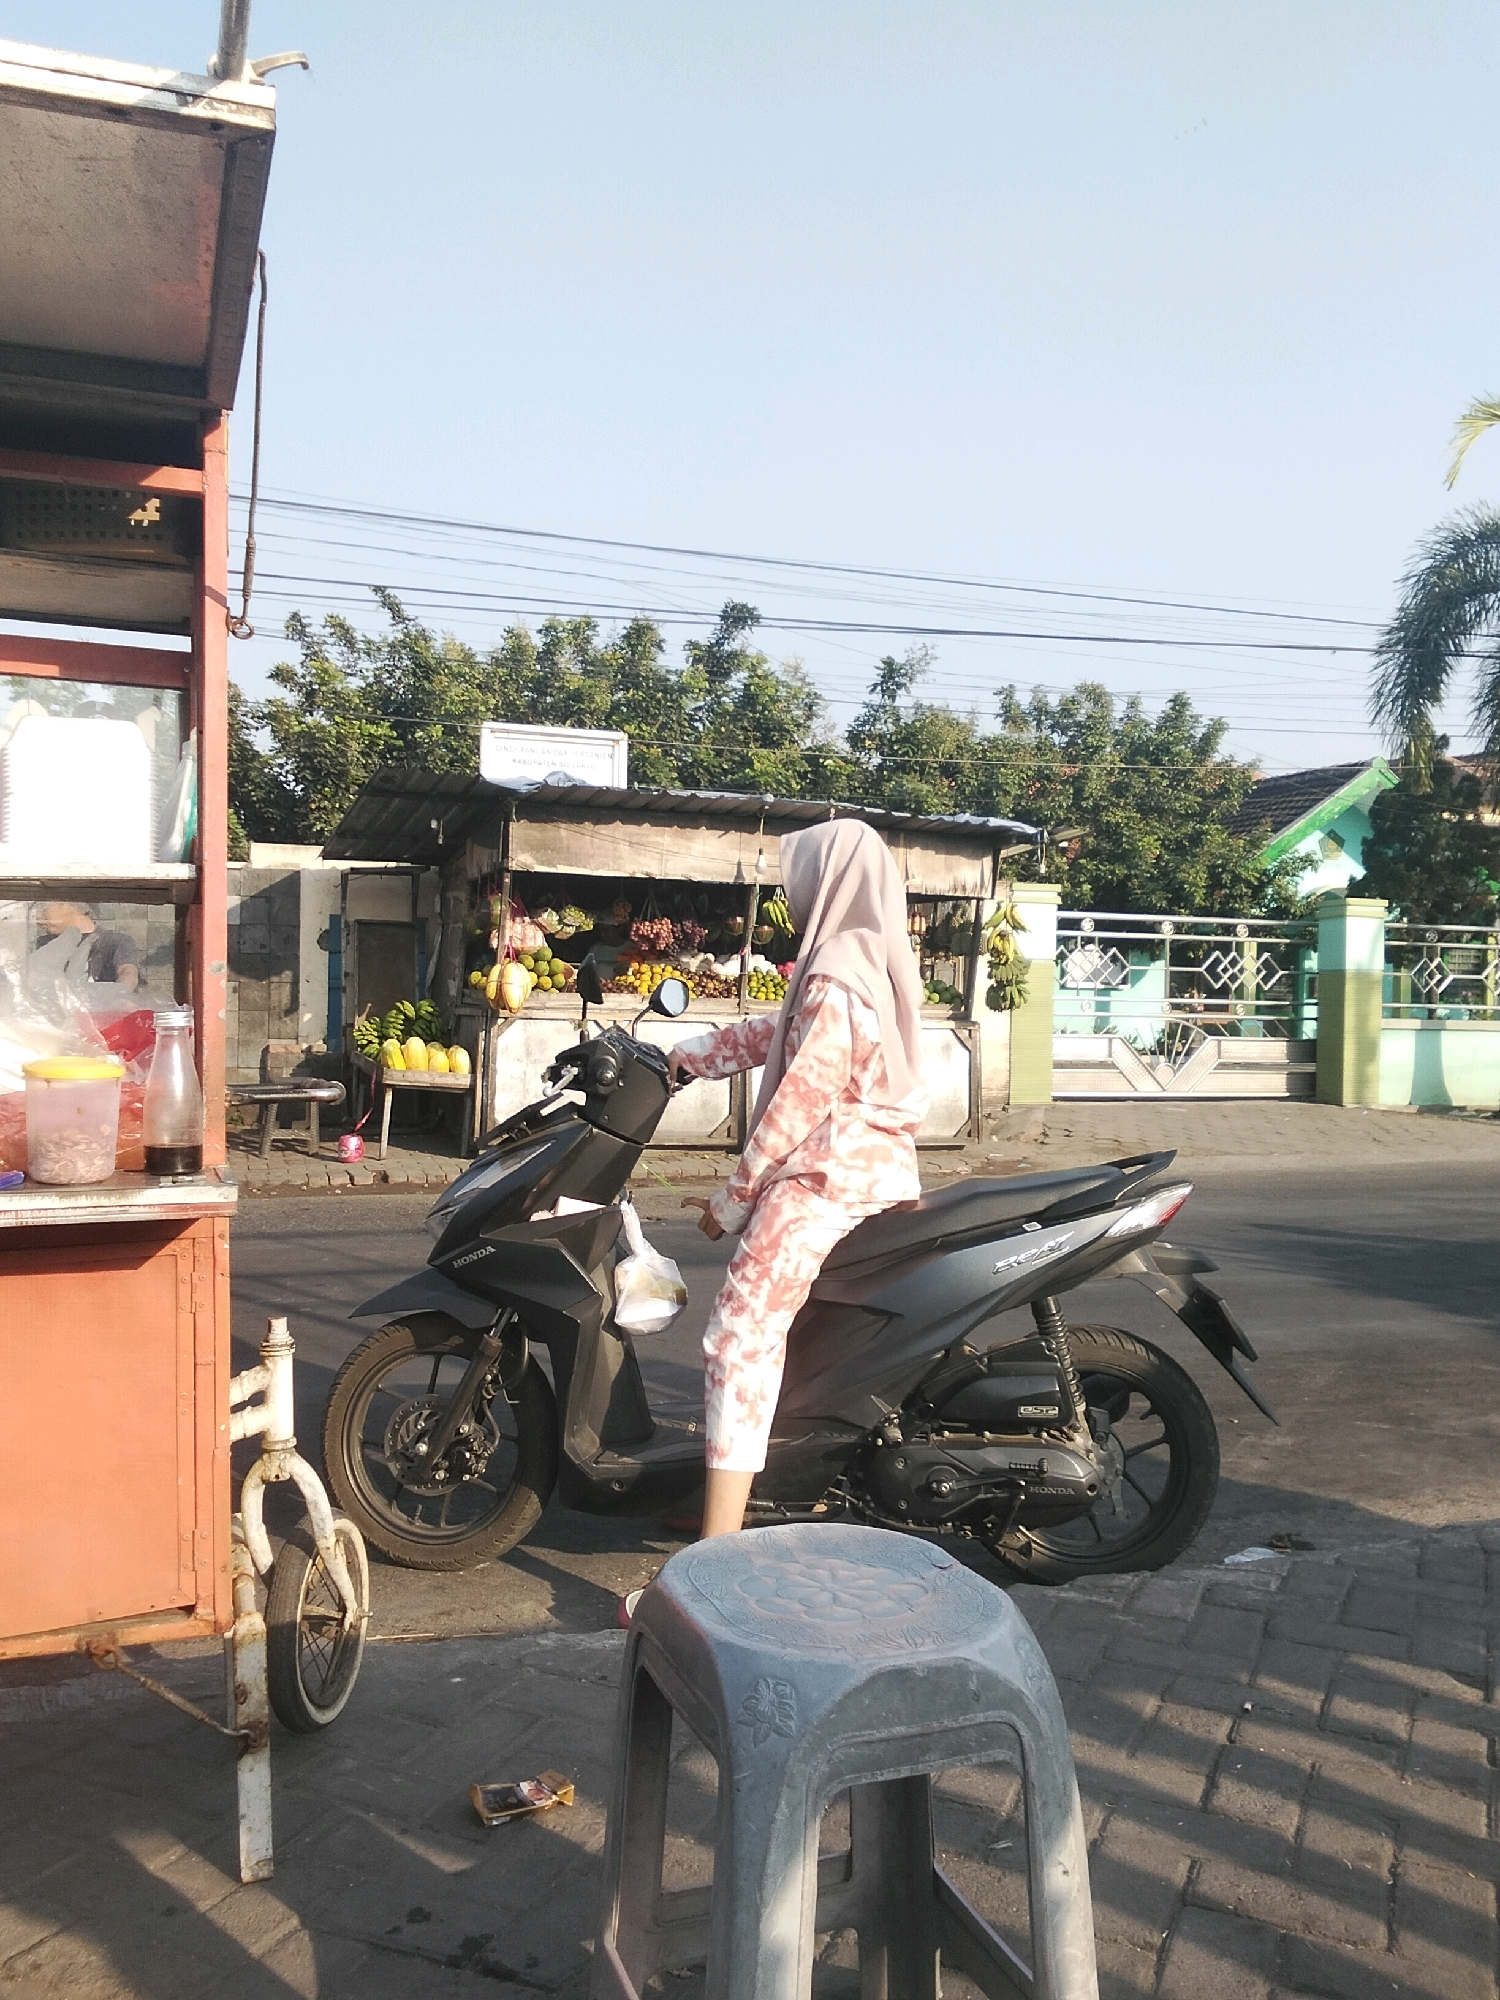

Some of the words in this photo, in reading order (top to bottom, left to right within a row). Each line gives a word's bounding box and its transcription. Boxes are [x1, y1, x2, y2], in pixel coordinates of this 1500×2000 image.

[495, 744, 518, 753] DINAS
[520, 746, 551, 755] PANGAN
[553, 748, 568, 756] DAN
[571, 750, 613, 760] PERTANIAN
[512, 758, 557, 768] KABUPATEN
[559, 761, 596, 770] SIDOARJO
[452, 1245, 497, 1269] HONDA
[1029, 1486, 1076, 1495] HONDA
